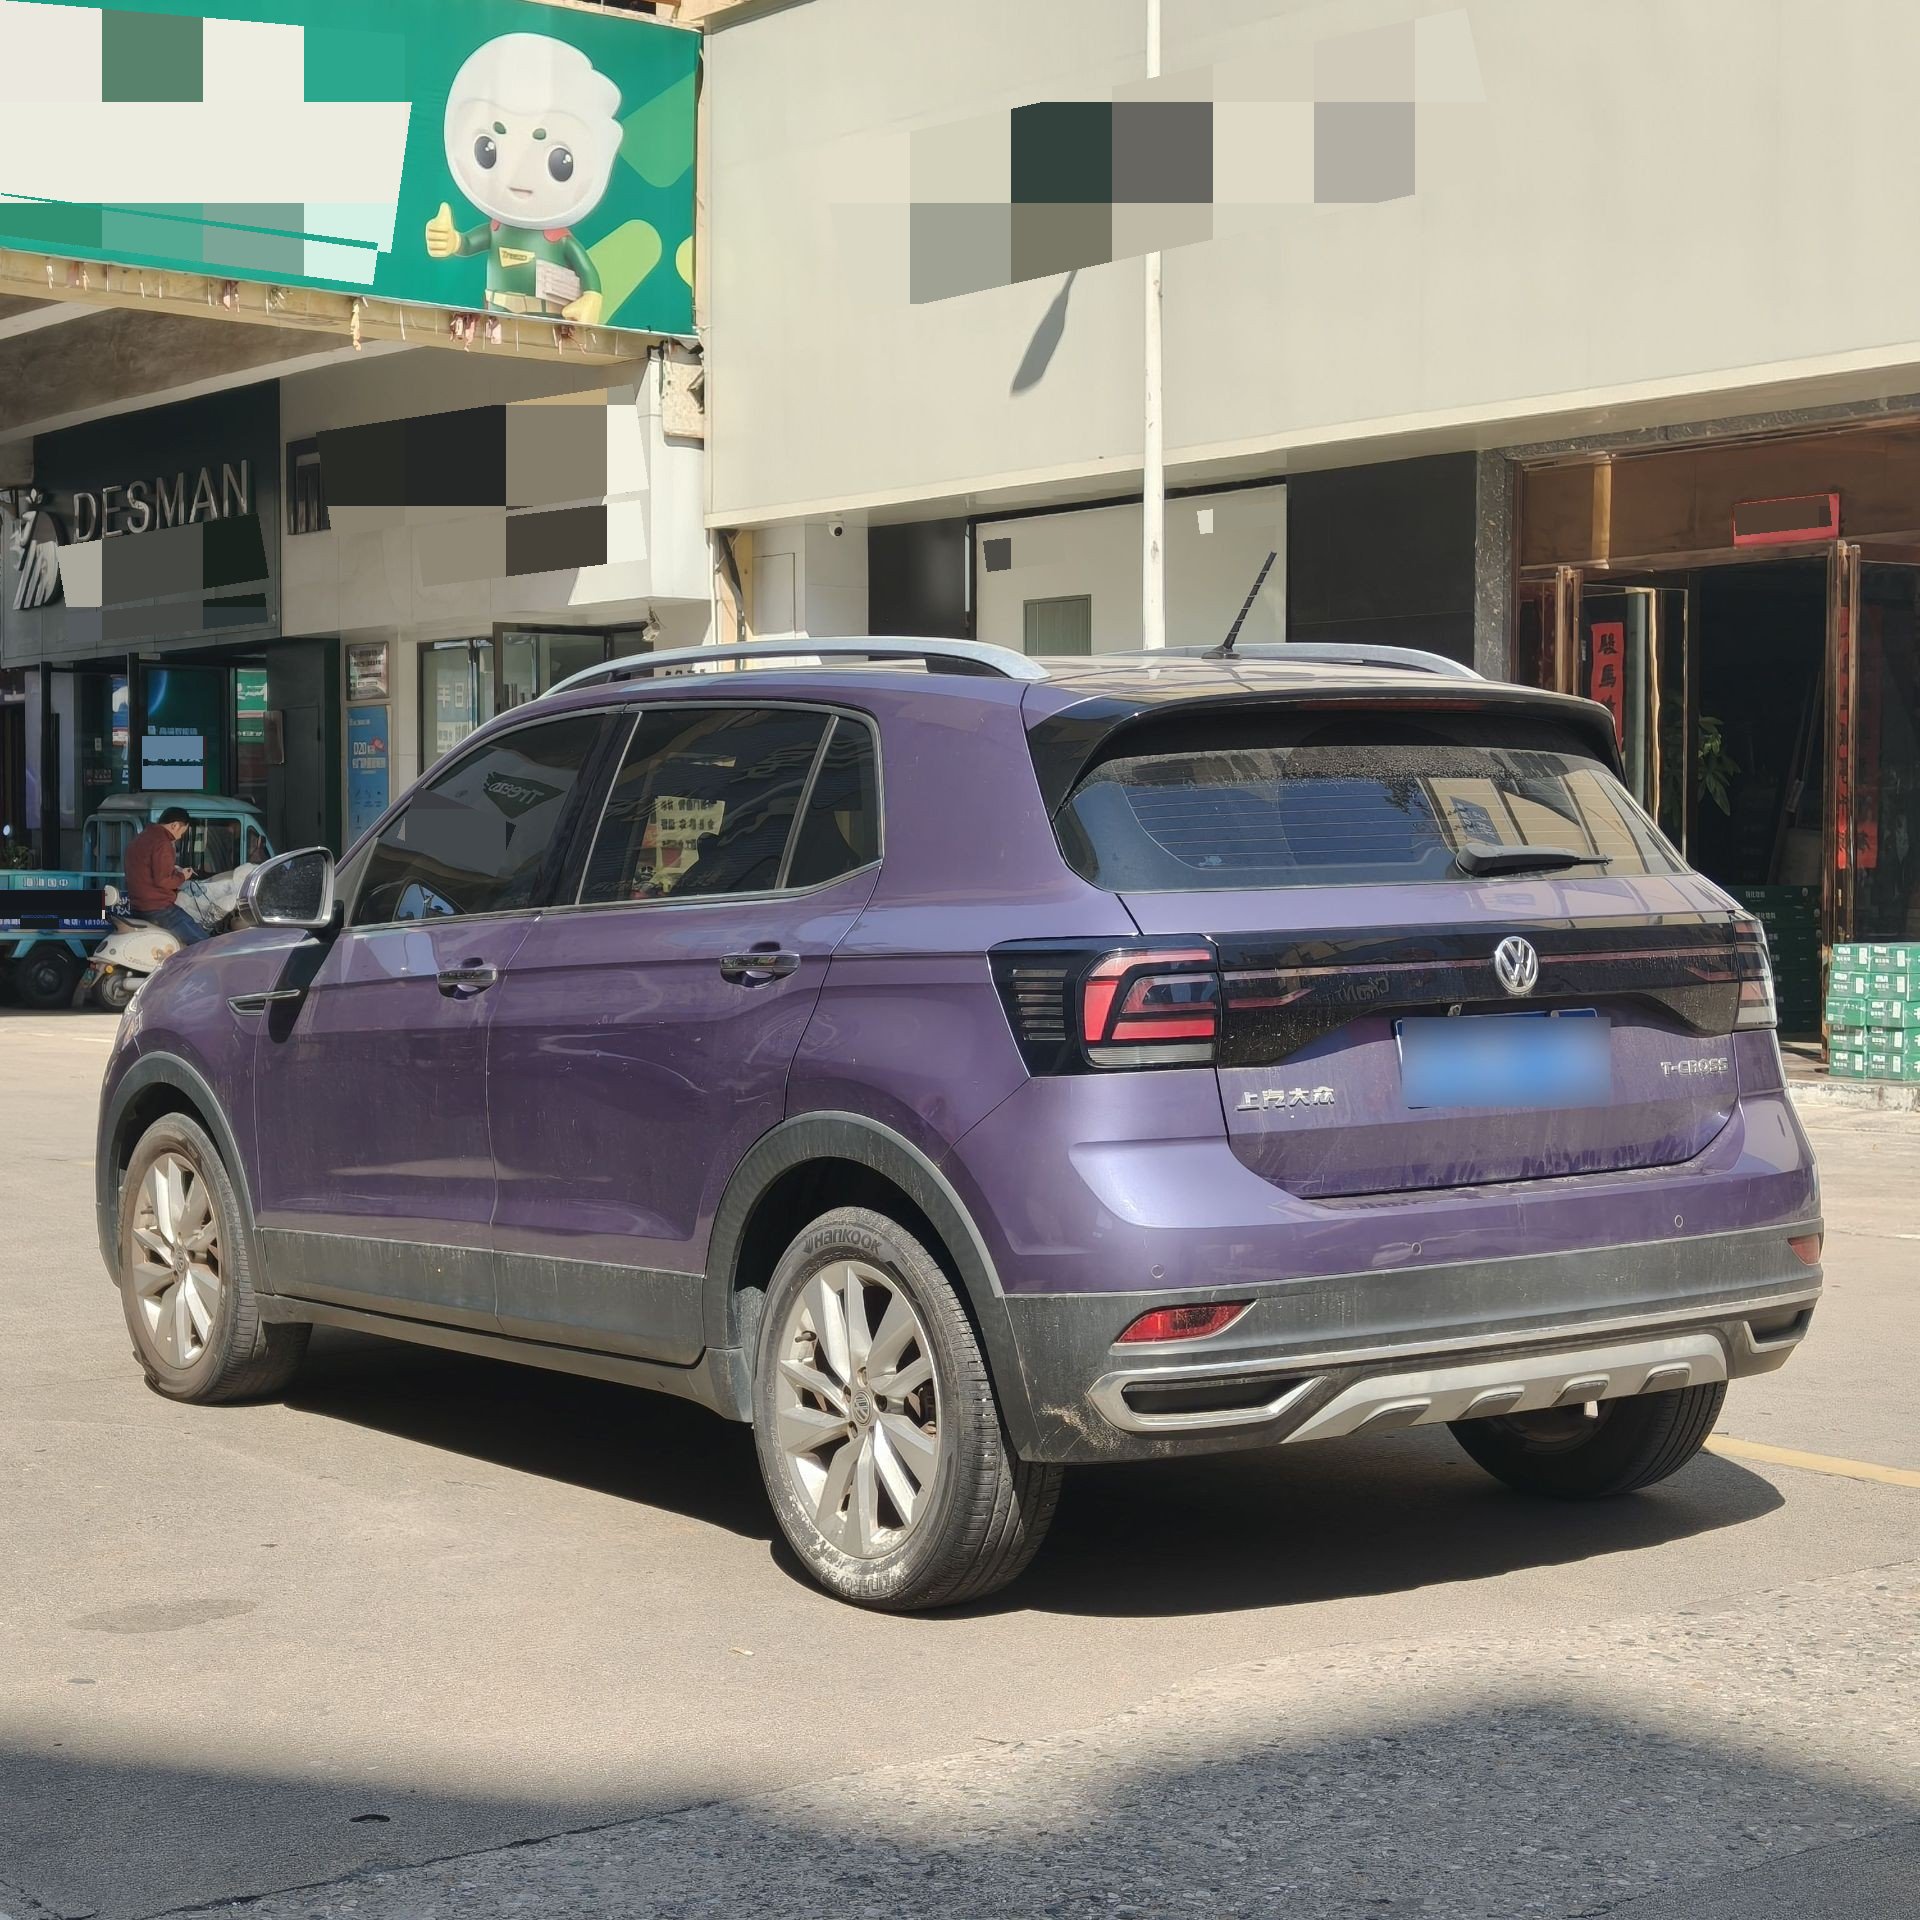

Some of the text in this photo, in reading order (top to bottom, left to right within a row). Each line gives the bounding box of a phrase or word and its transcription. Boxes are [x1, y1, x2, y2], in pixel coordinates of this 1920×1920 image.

[73, 459, 248, 543] DESMAN
[1660, 1057, 1729, 1077] T-CROSS
[1236, 1086, 1335, 1111] 上汽大众
